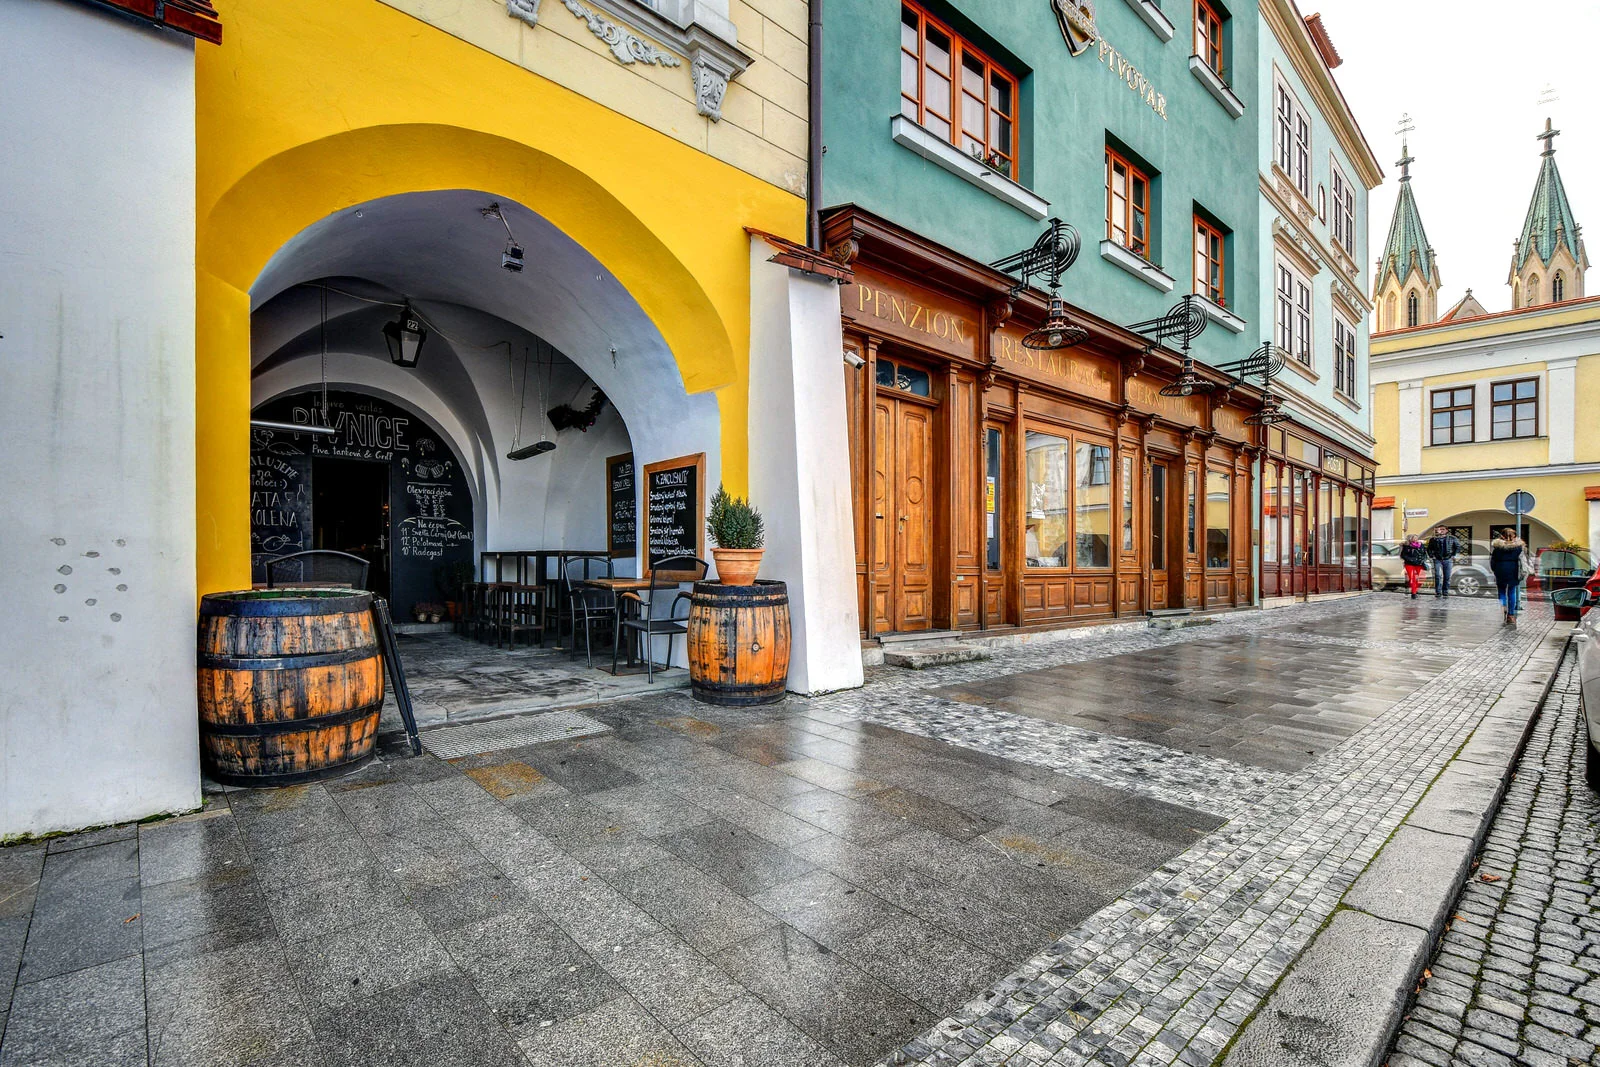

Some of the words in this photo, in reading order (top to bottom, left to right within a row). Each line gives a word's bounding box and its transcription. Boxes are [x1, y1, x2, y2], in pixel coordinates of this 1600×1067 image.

[1097, 36, 1168, 121] PIVOVAR
[408, 320, 418, 330] 22
[857, 284, 964, 344] PENZION
[1000, 335, 1107, 389] RESTAURACE
[293, 407, 410, 450] PIVNICE
[412, 546, 444, 561] Radegast
